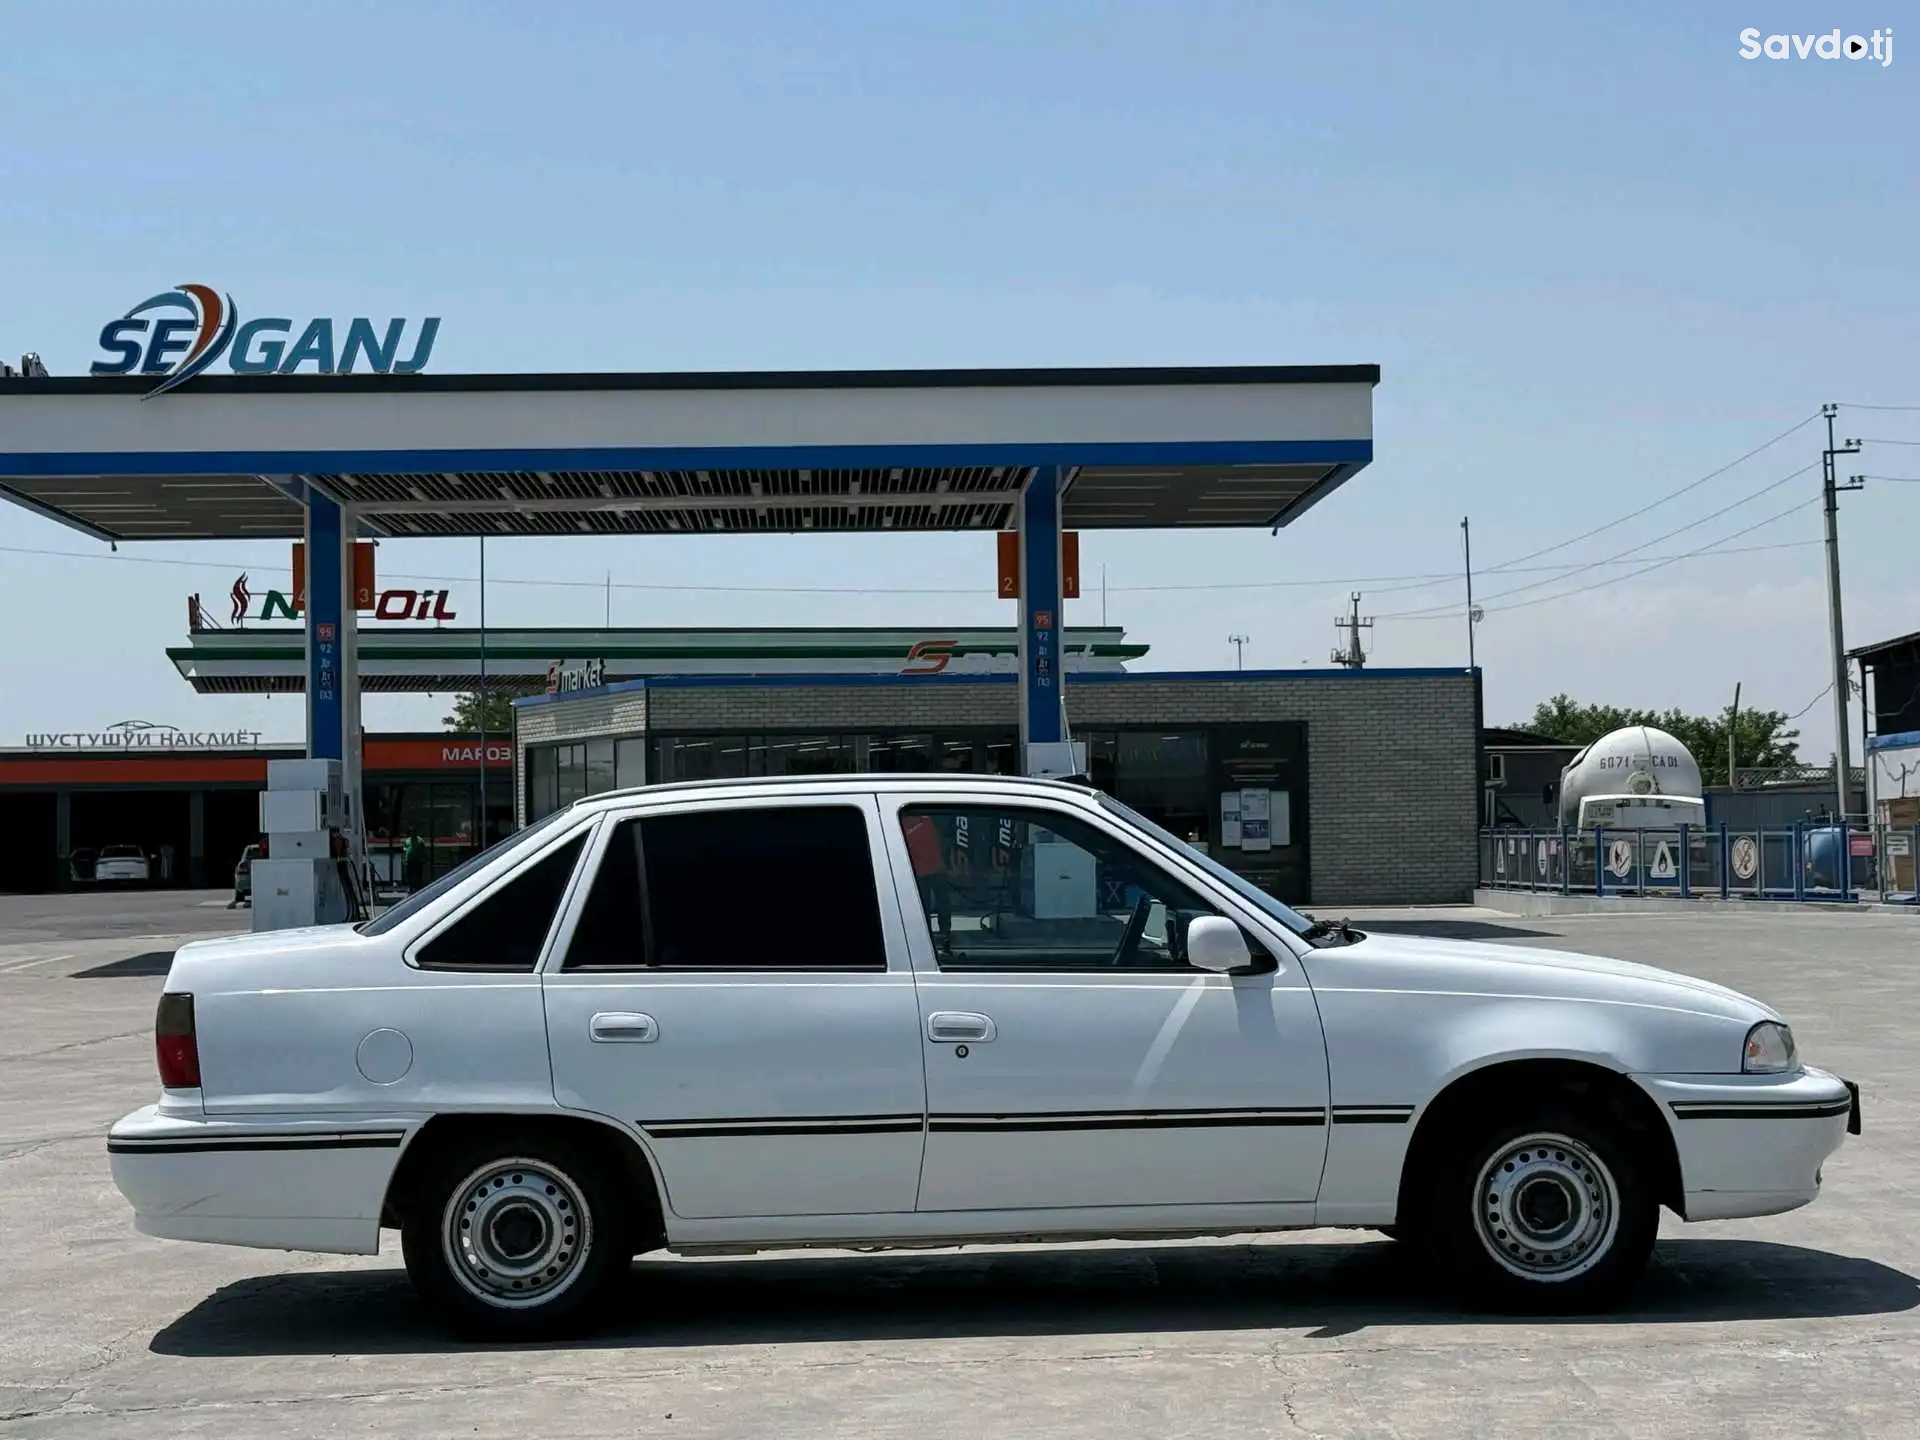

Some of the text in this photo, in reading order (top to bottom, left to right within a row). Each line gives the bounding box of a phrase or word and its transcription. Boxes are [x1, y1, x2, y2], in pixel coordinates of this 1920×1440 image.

[1003, 576, 1013, 592] 2
[1066, 576, 1073, 591] 1
[359, 588, 369, 603] 3
[1036, 615, 1049, 625] 95
[320, 627, 332, 637] 95
[1037, 631, 1049, 641] 92
[320, 643, 332, 654] 92
[1600, 755, 1629, 769] 6071
